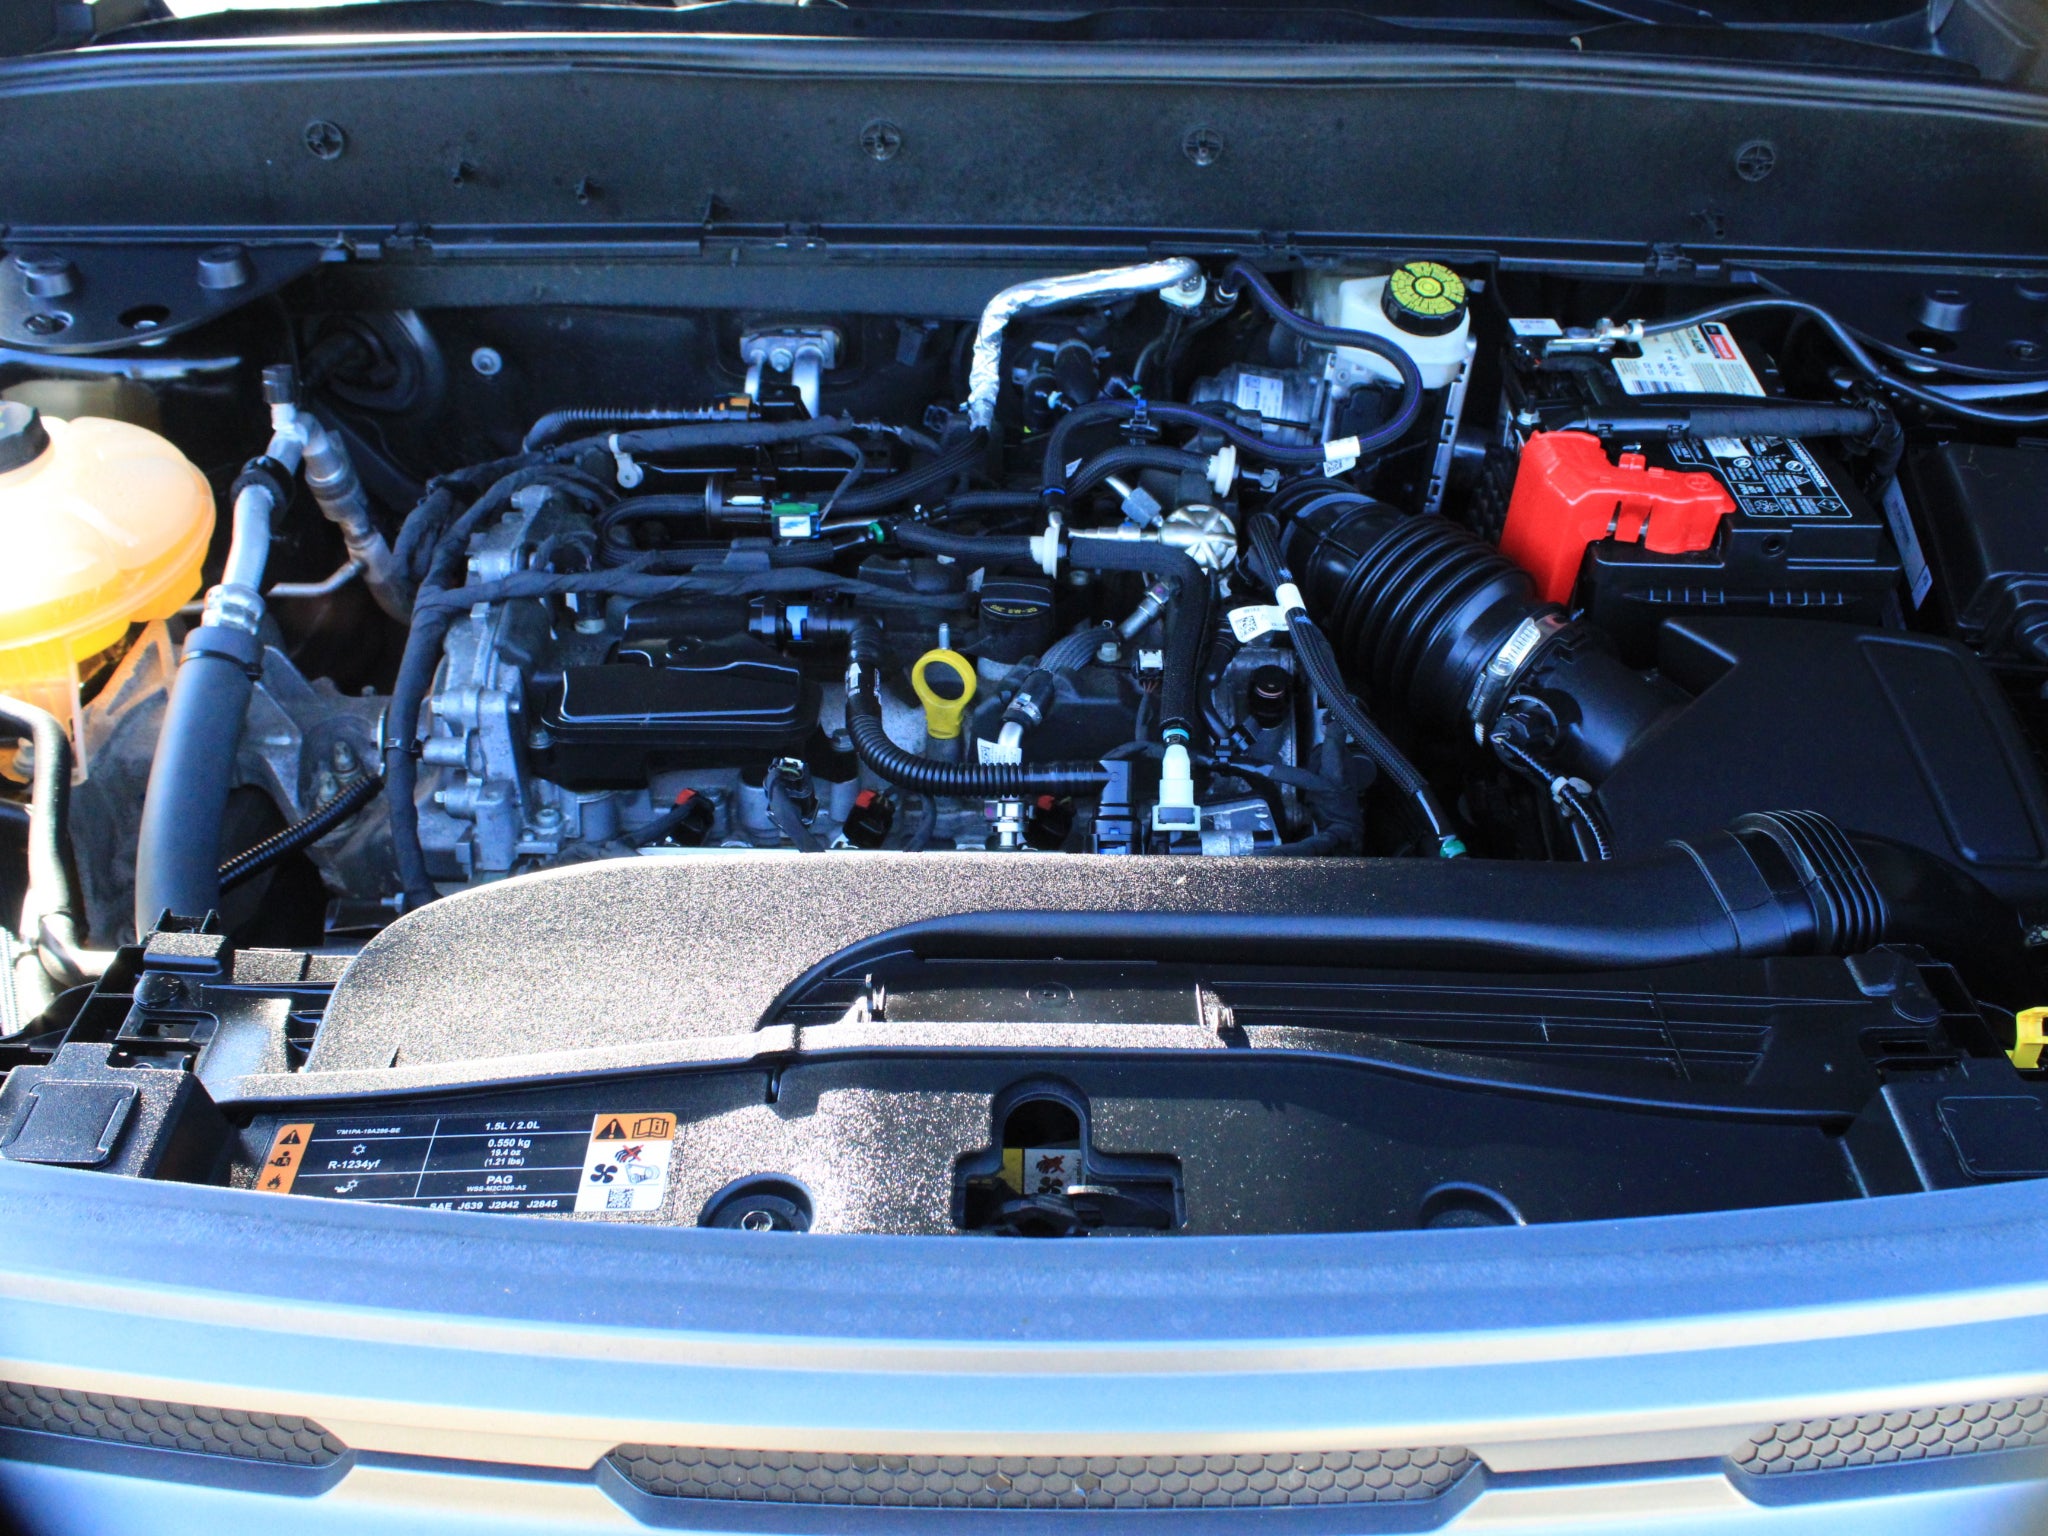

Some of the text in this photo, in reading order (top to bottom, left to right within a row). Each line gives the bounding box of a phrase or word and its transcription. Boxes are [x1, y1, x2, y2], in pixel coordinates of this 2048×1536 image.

[485, 1121, 508, 1131] 1.5L
[516, 1120, 541, 1130] 2.0L
[487, 1137, 532, 1149] 0.550 kg
[490, 1148, 522, 1157] 19.4 oz
[327, 1159, 382, 1171] R-1234yf
[484, 1156, 525, 1168] (1.21 lbs)
[486, 1174, 514, 1185] PAG
[429, 1198, 559, 1211] SAE J639 J2842 J2845
